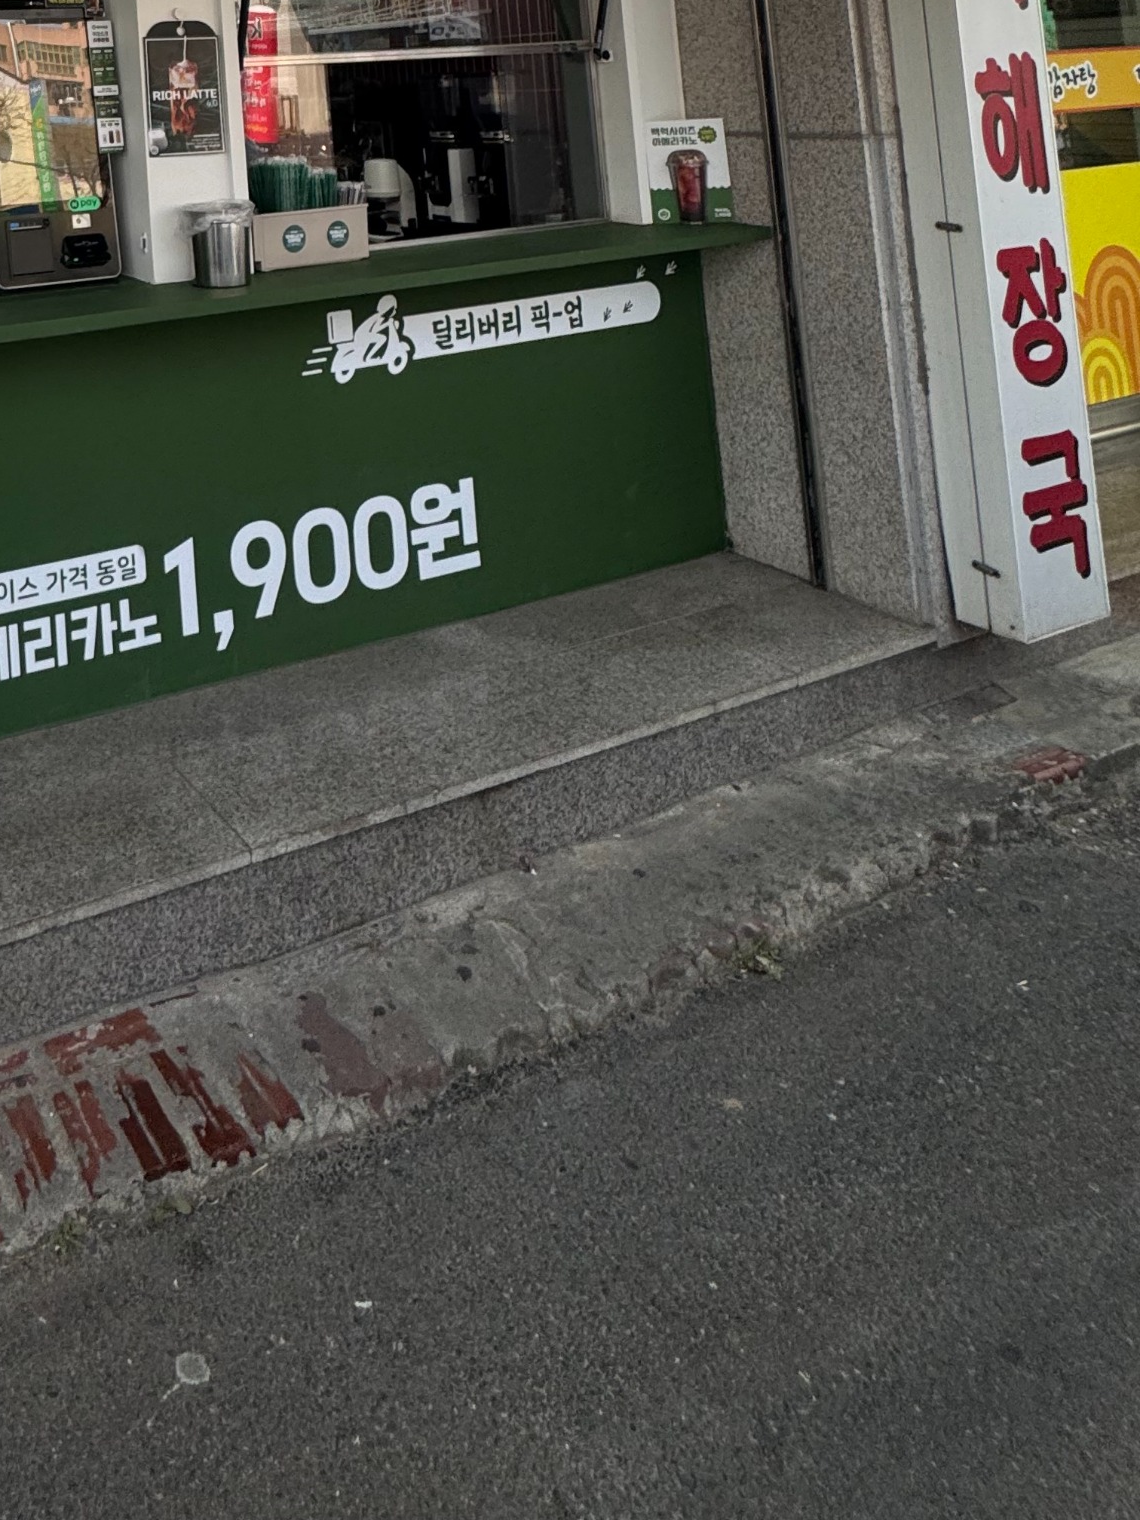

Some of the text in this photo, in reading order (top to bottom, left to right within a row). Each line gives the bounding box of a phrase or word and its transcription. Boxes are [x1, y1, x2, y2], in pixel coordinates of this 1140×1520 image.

[152, 88, 218, 102] RICH LATTE
[81, 198, 98, 208] pay
[432, 295, 585, 350] 딜리버리 픽-업
[46, 563, 90, 595] 가격
[97, 552, 139, 586] 동일
[163, 477, 482, 651] 1,900원
